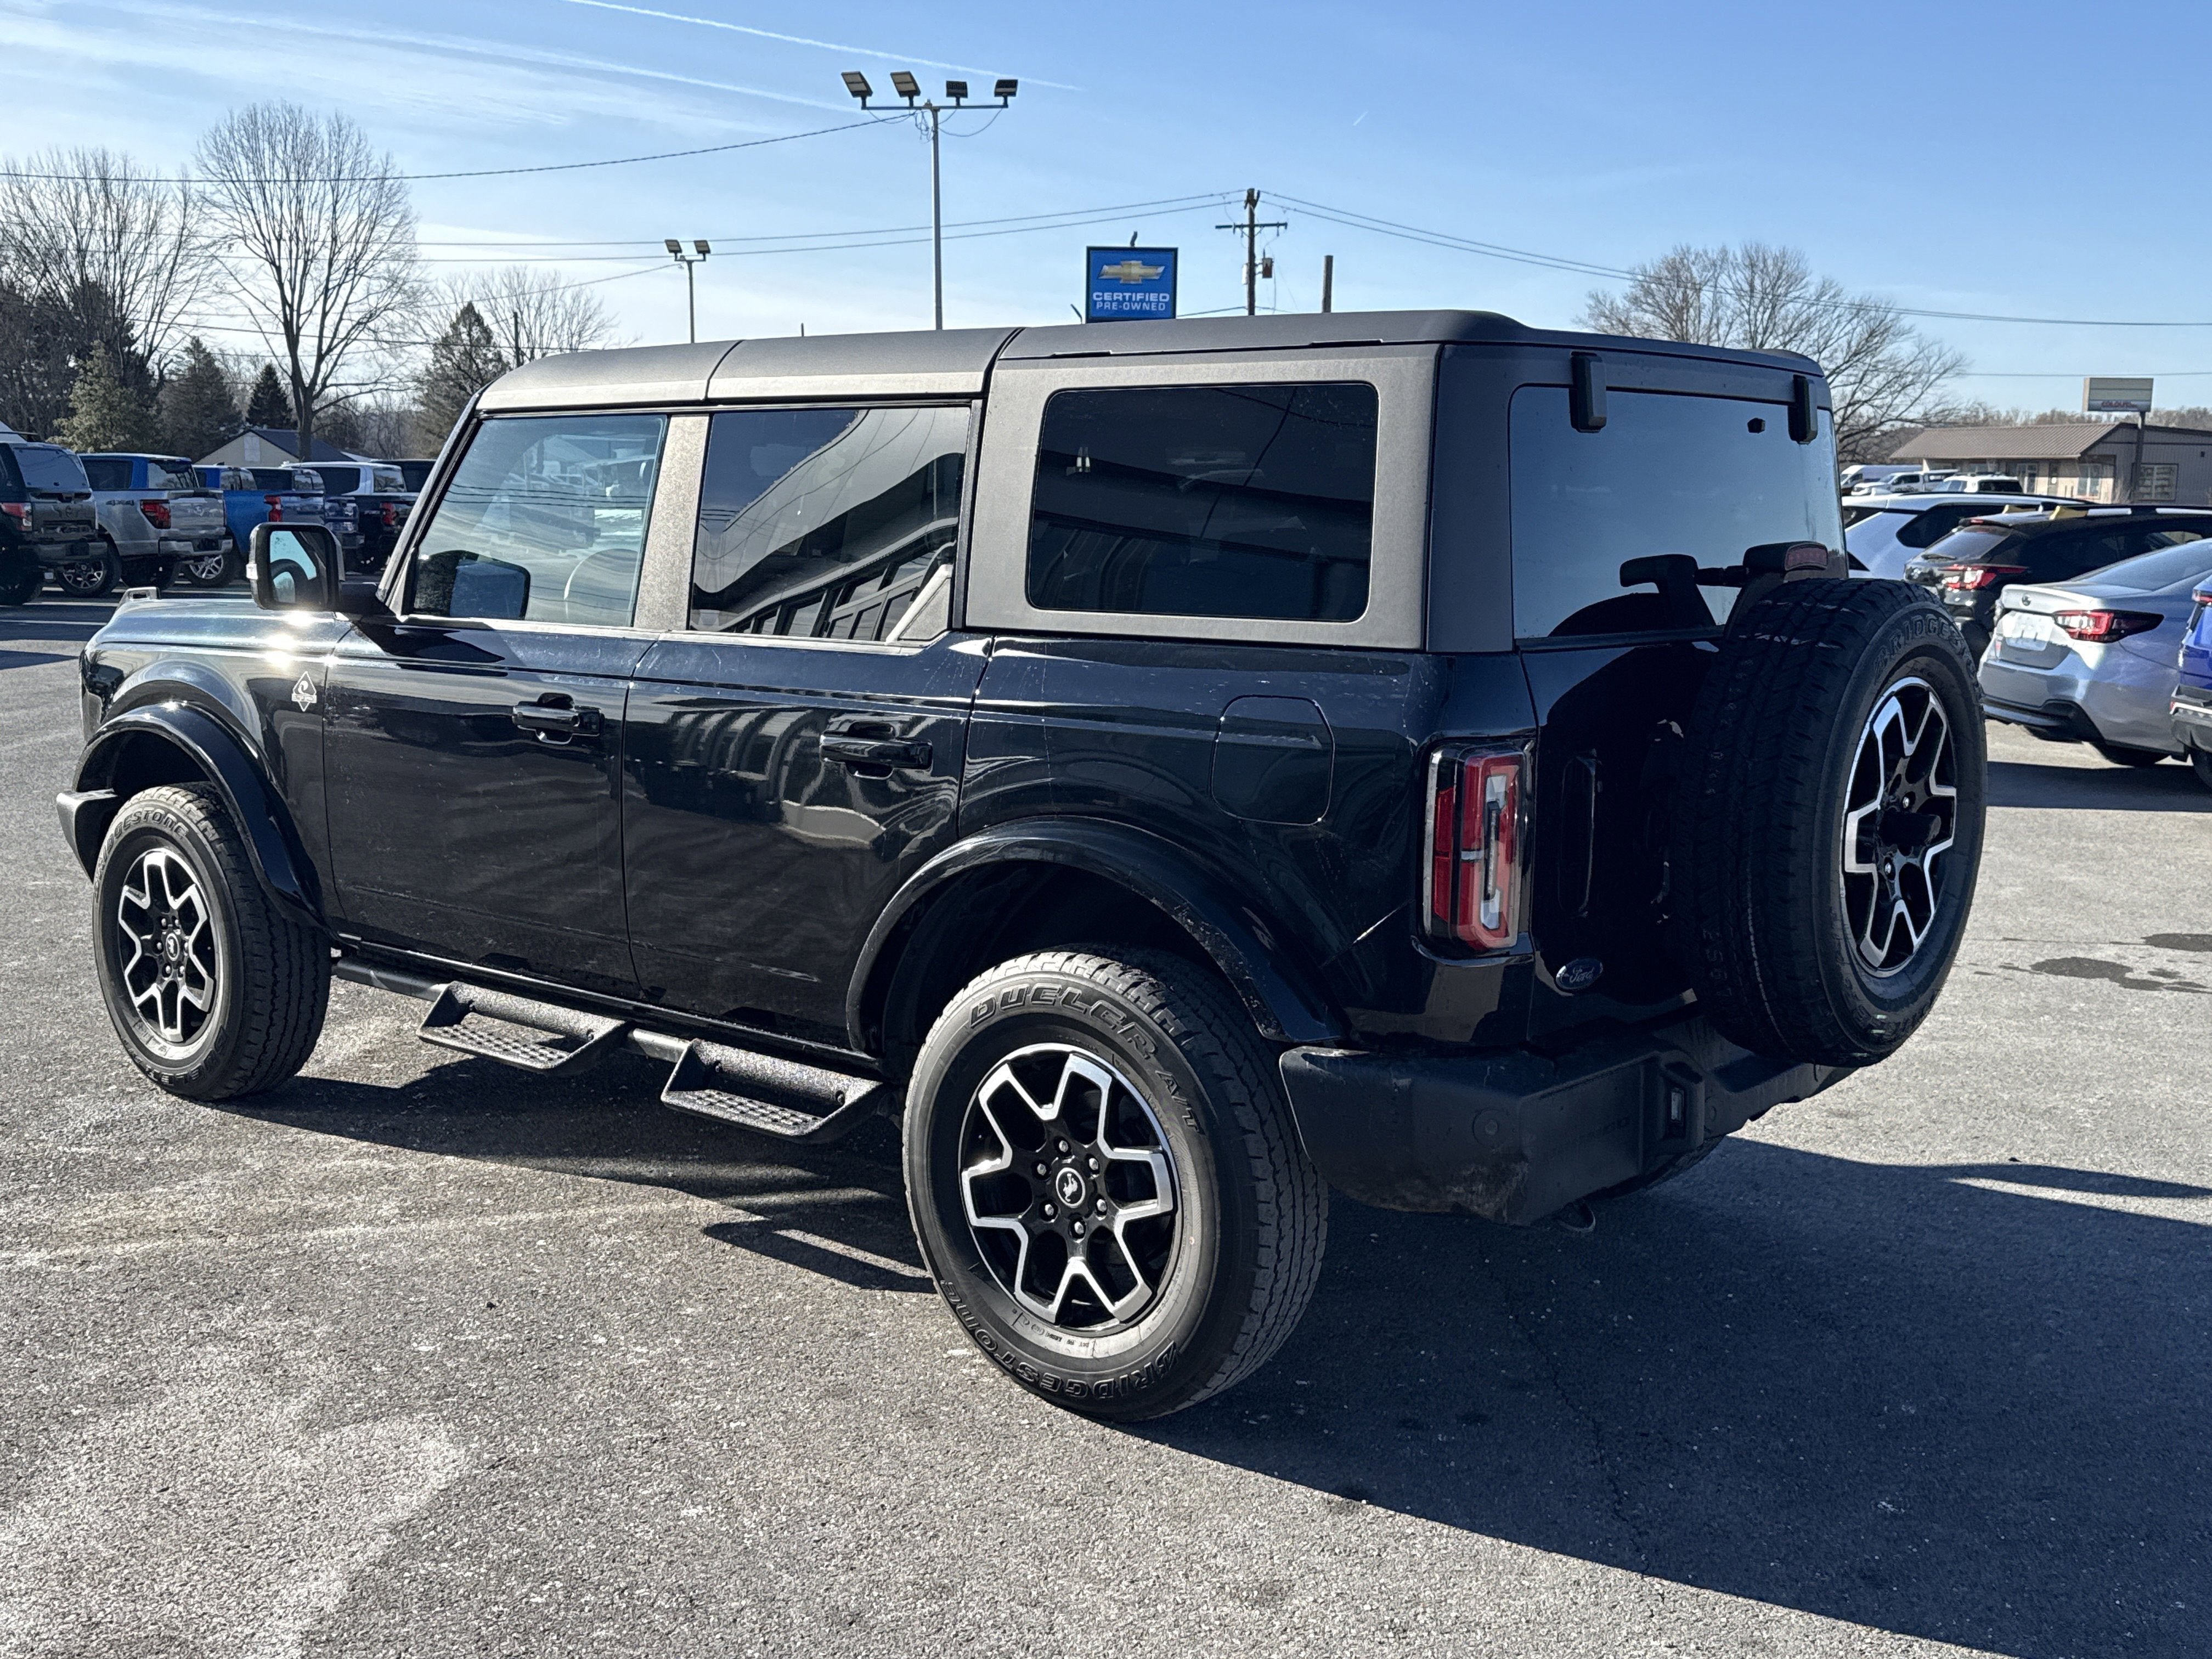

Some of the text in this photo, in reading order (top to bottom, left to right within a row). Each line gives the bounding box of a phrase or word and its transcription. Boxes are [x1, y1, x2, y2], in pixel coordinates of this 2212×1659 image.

[1093, 292, 1170, 302] CERTIFIED
[1096, 302, 1166, 311] PRE-OWNED
[1569, 966, 1594, 984] Ford
[968, 982, 1158, 1060] DUELER
[939, 1279, 1179, 1400] BRIDGESTONE
